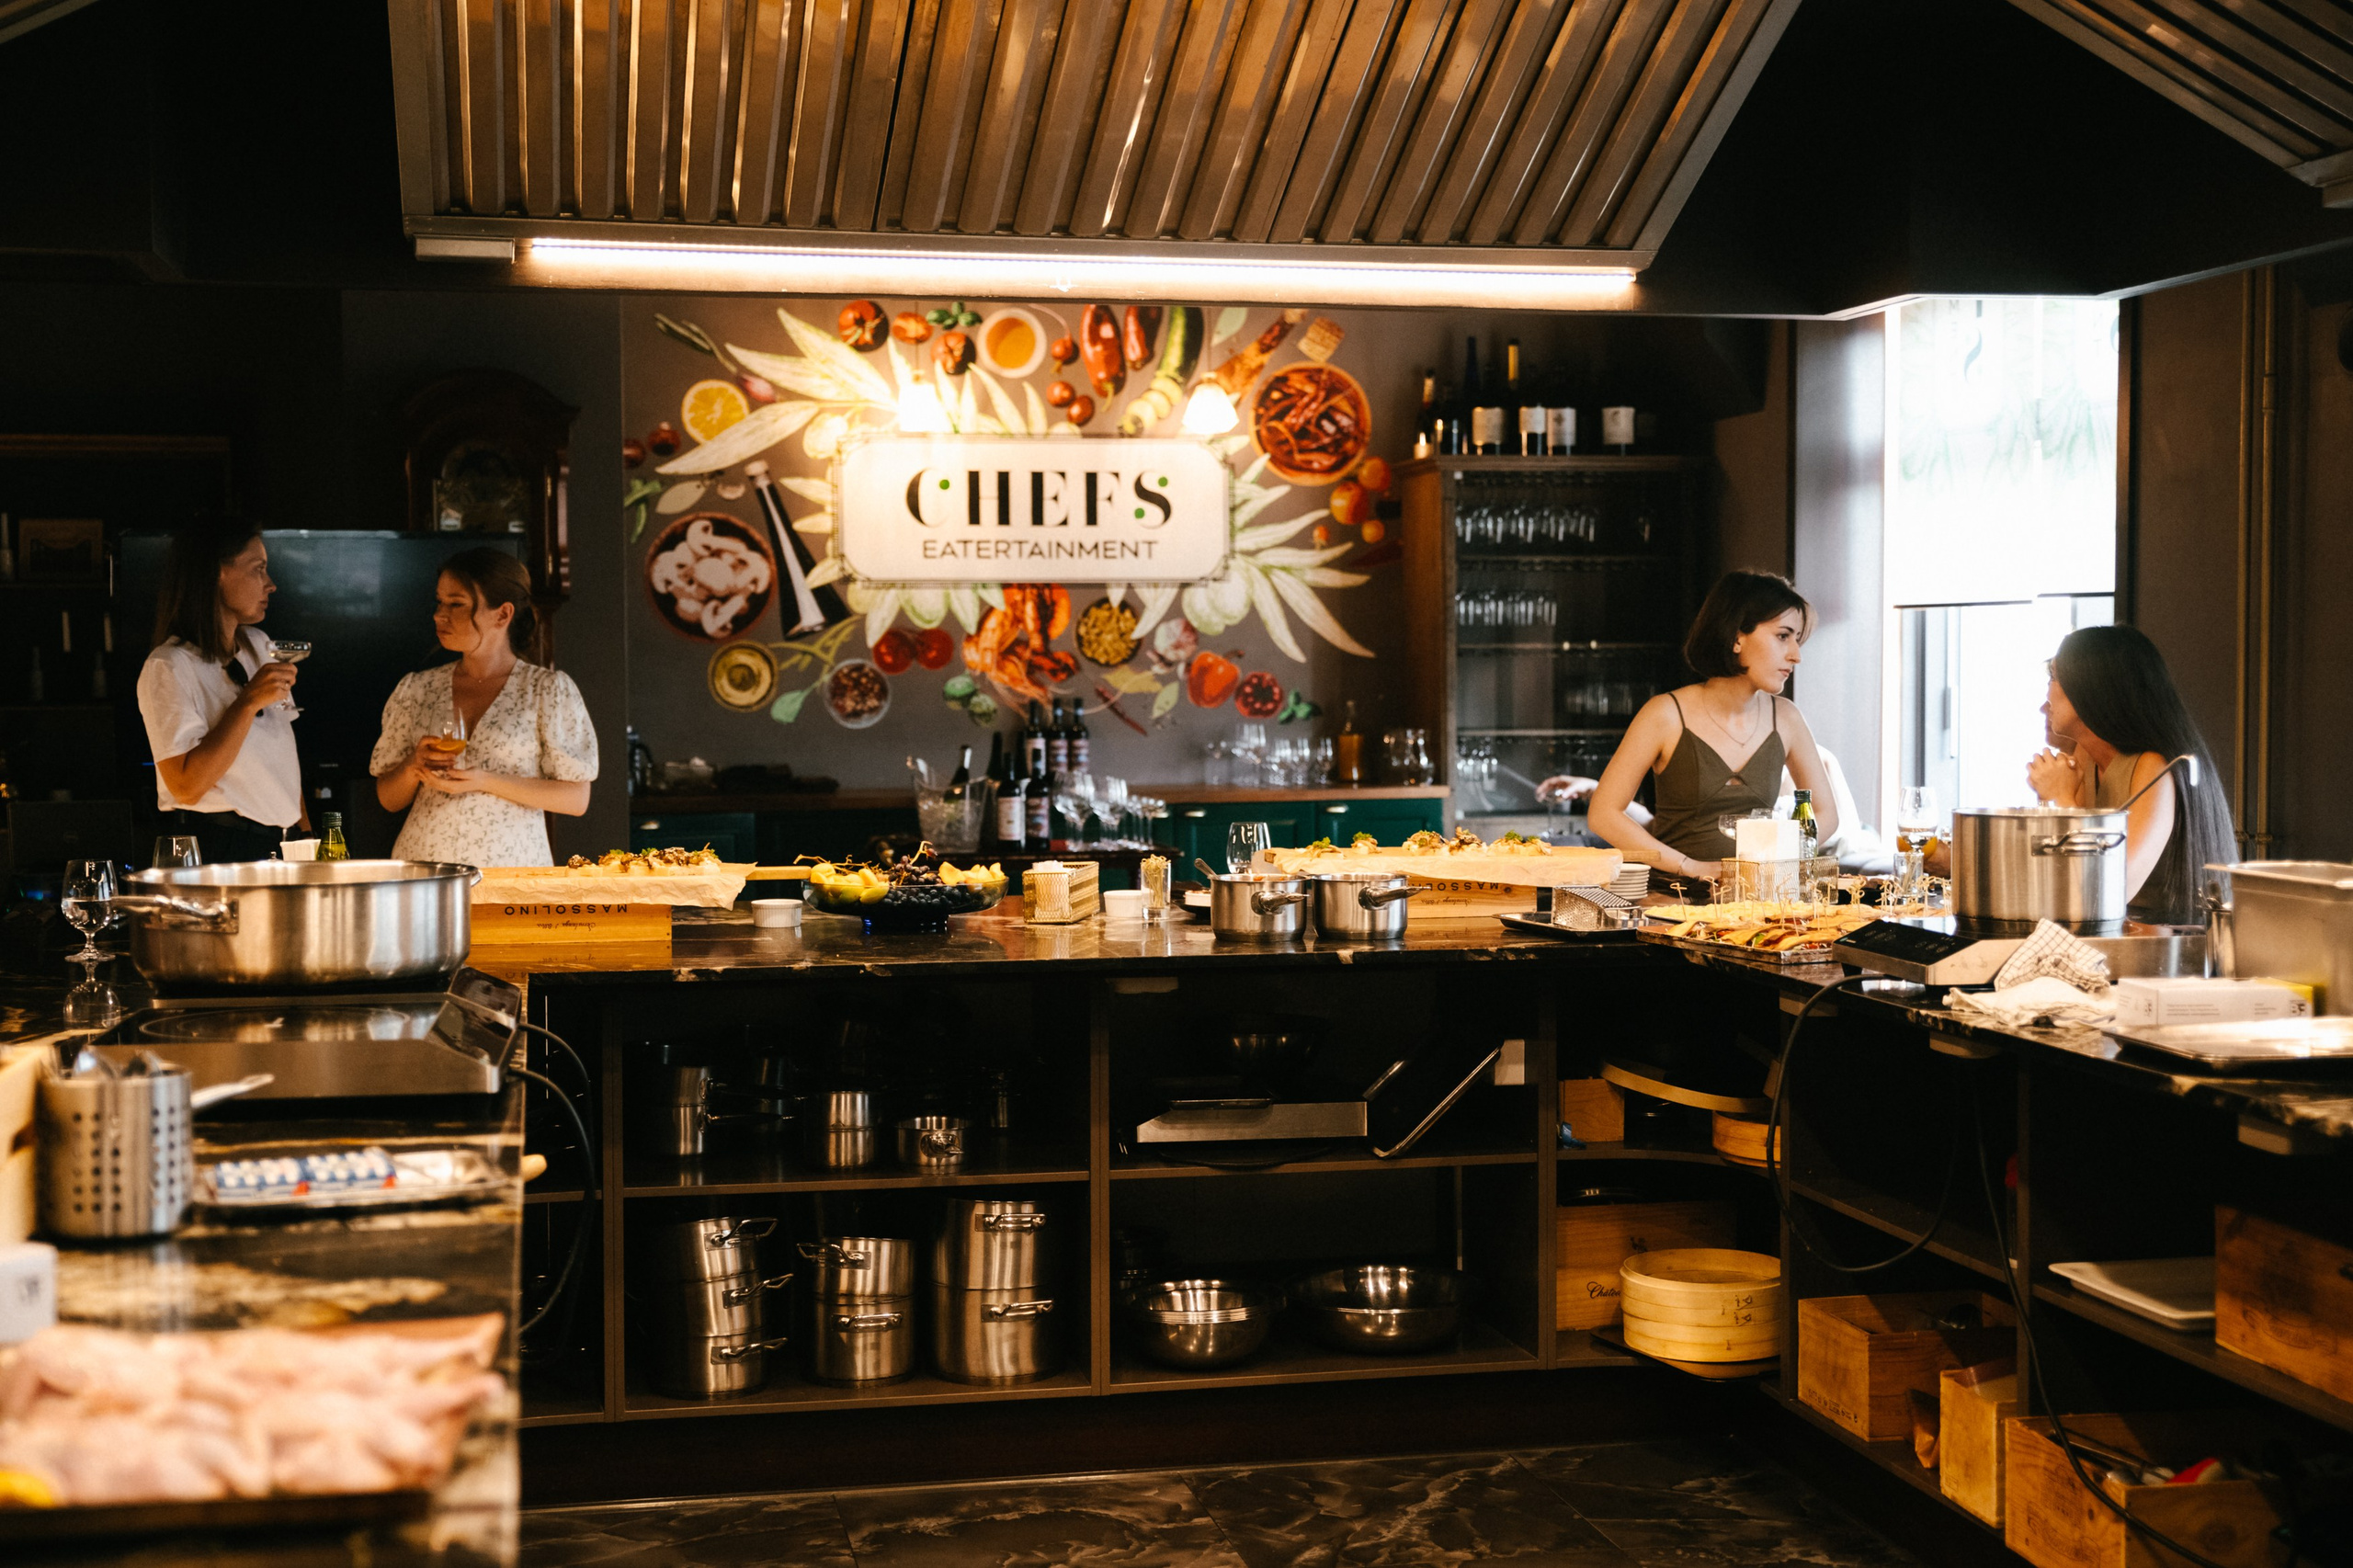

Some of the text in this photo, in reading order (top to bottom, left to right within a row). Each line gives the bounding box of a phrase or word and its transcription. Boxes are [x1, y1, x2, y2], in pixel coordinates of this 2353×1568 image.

[905, 467, 1173, 529] CHEFS
[923, 540, 1159, 559] EATERTAINMENT
[1408, 882, 1499, 892] MASSOL
[505, 904, 628, 915] MASSOLINO
[1586, 1281, 1621, 1300] Châtea
